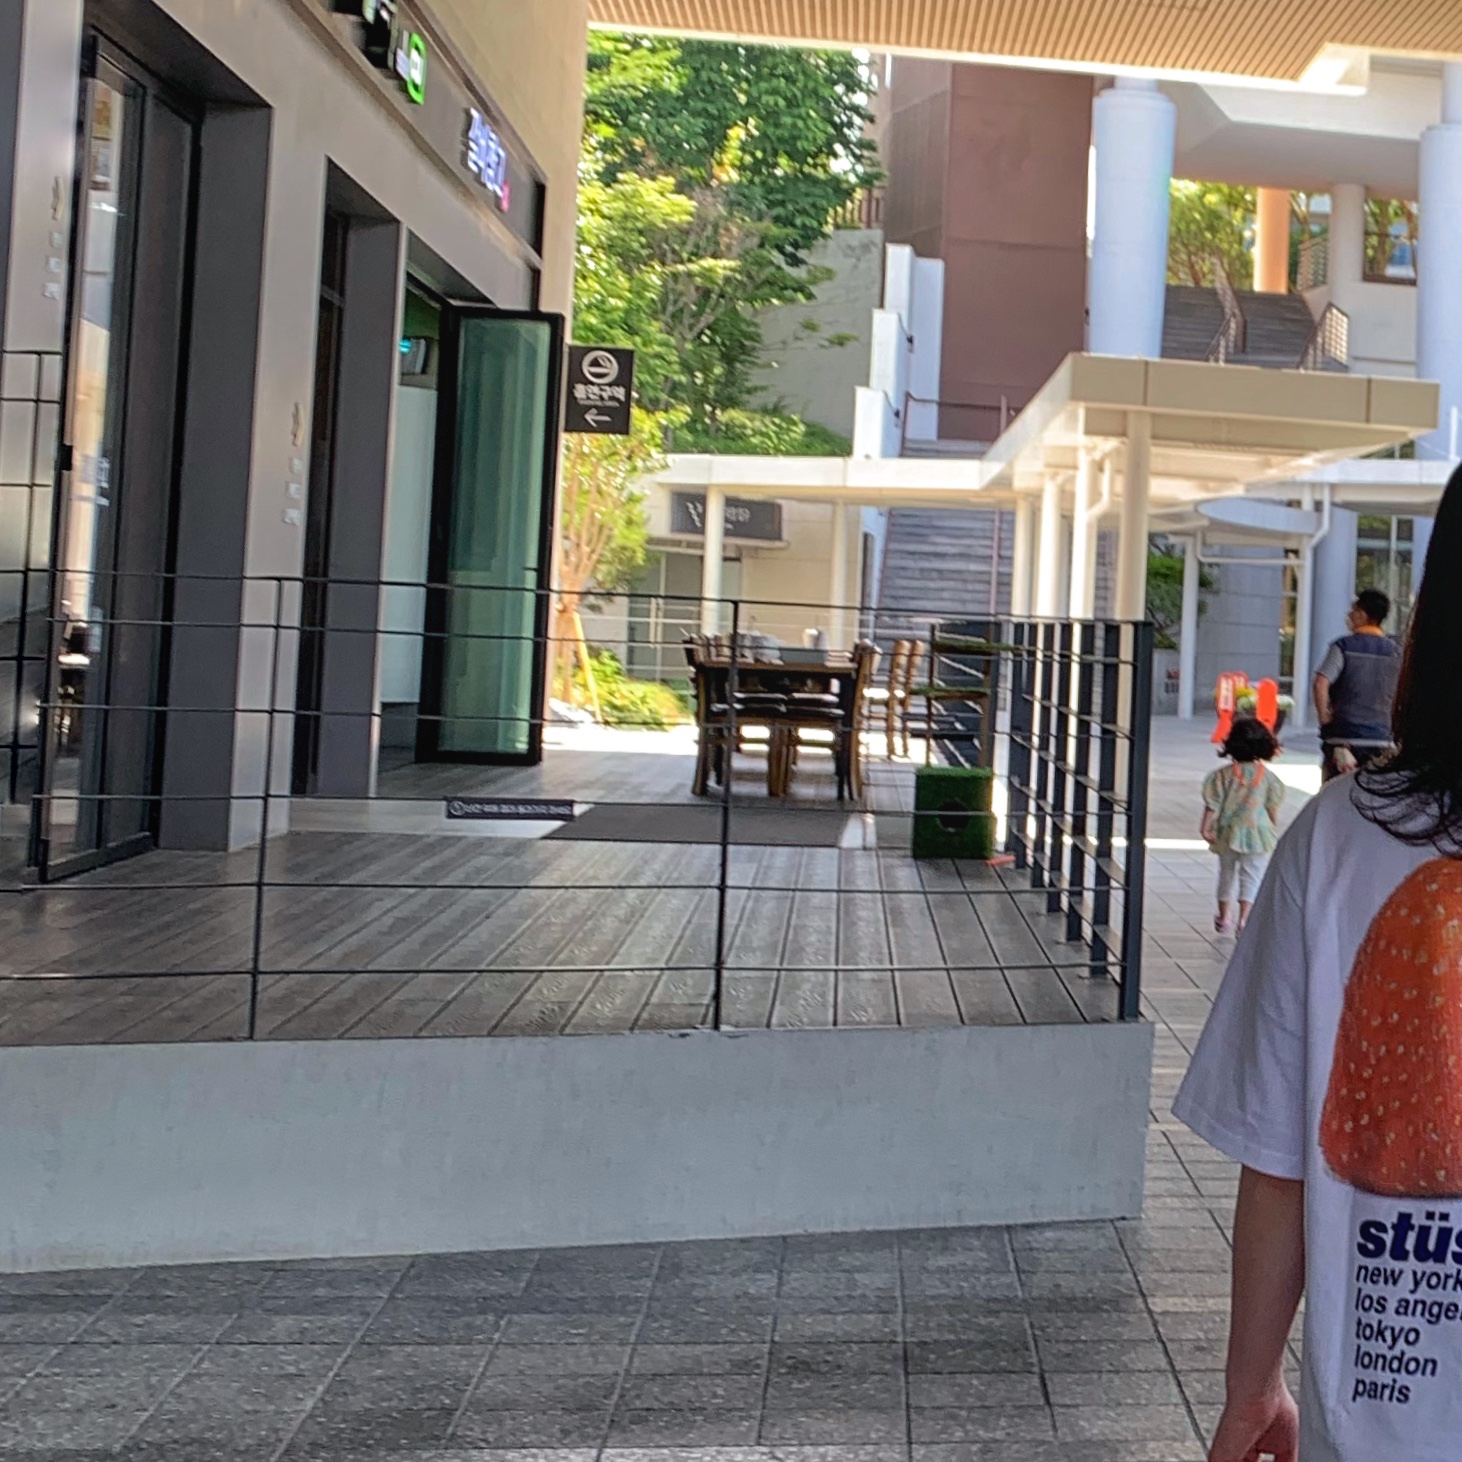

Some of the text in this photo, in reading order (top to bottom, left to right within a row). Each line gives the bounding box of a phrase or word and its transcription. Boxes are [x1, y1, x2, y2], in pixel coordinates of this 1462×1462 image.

[1355, 1264, 1403, 1286] new
[1355, 1287, 1388, 1313] los
[1355, 1317, 1421, 1350] tokyo
[1353, 1345, 1438, 1377] london
[1352, 1377, 1411, 1403] paris
